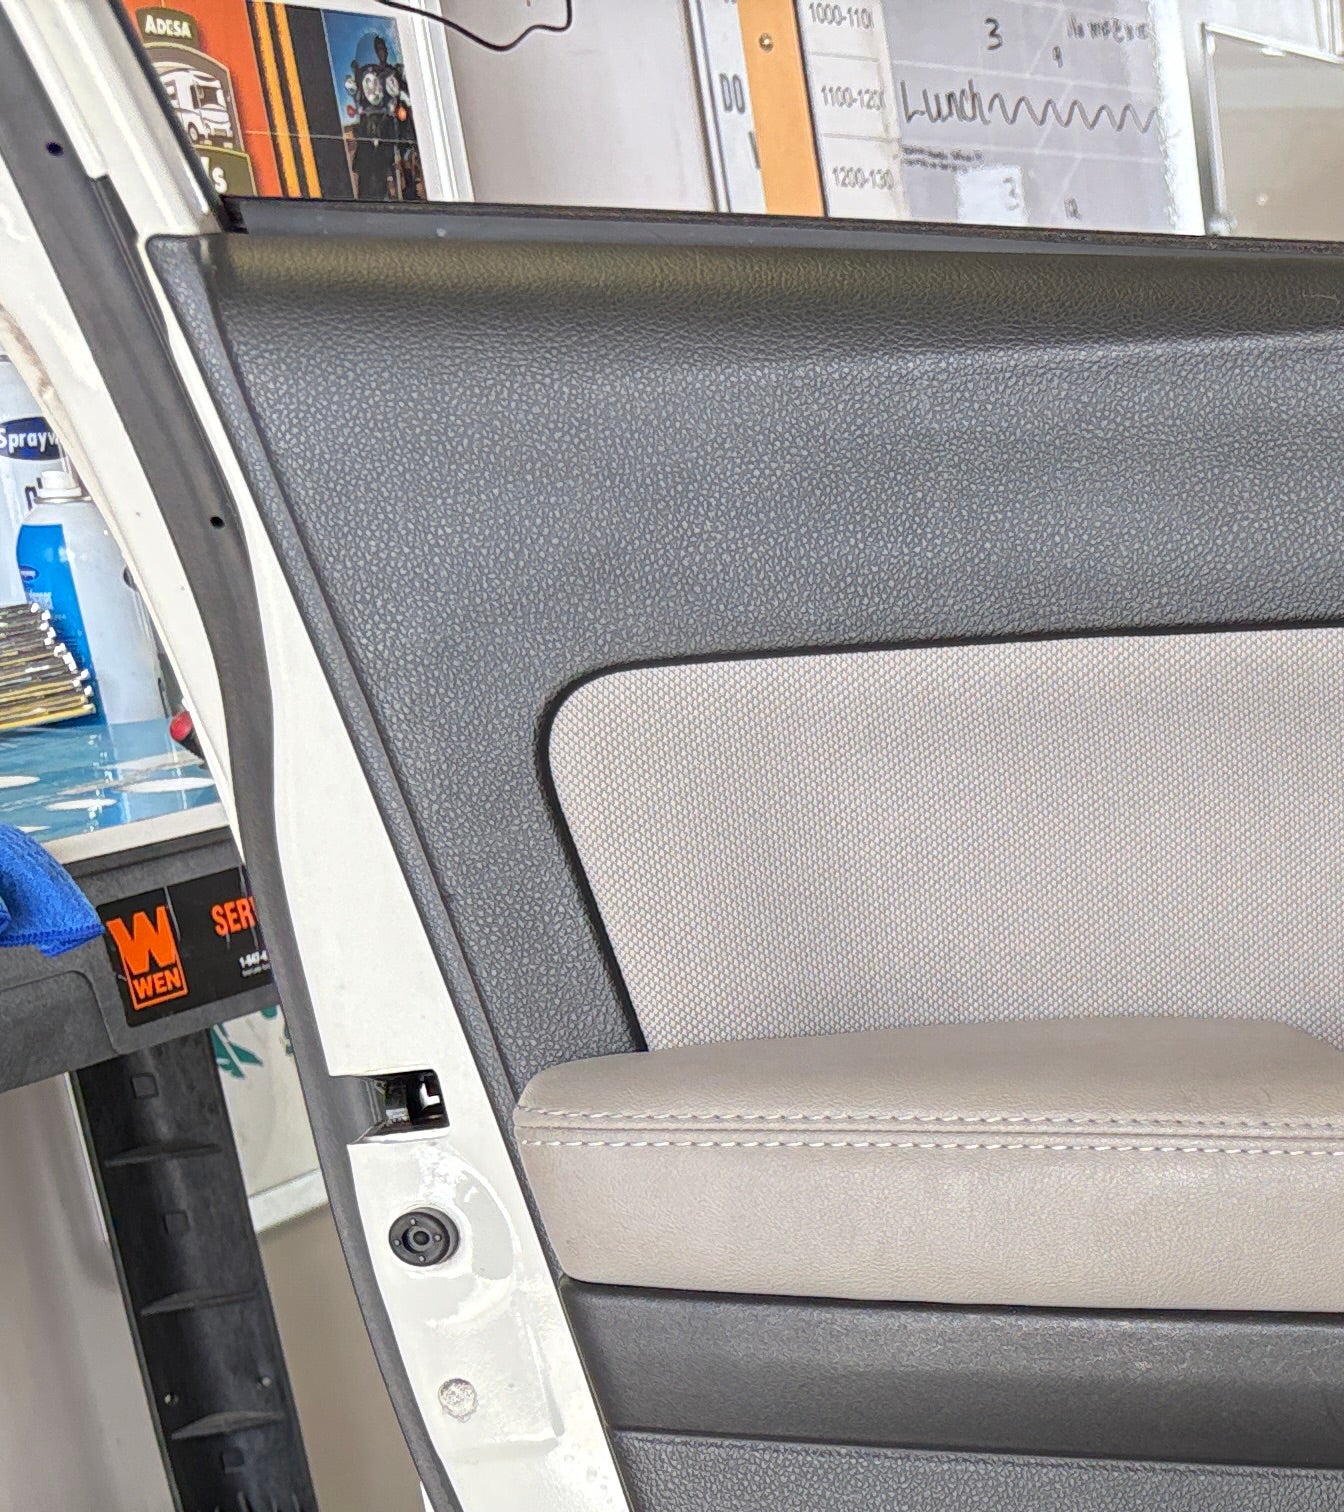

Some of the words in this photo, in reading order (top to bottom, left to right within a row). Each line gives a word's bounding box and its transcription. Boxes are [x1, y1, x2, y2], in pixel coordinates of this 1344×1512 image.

[144, 14, 193, 39] ADESA
[984, 18, 1003, 50] 3
[900, 79, 991, 125] Lunch
[132, 967, 182, 999] WEN
